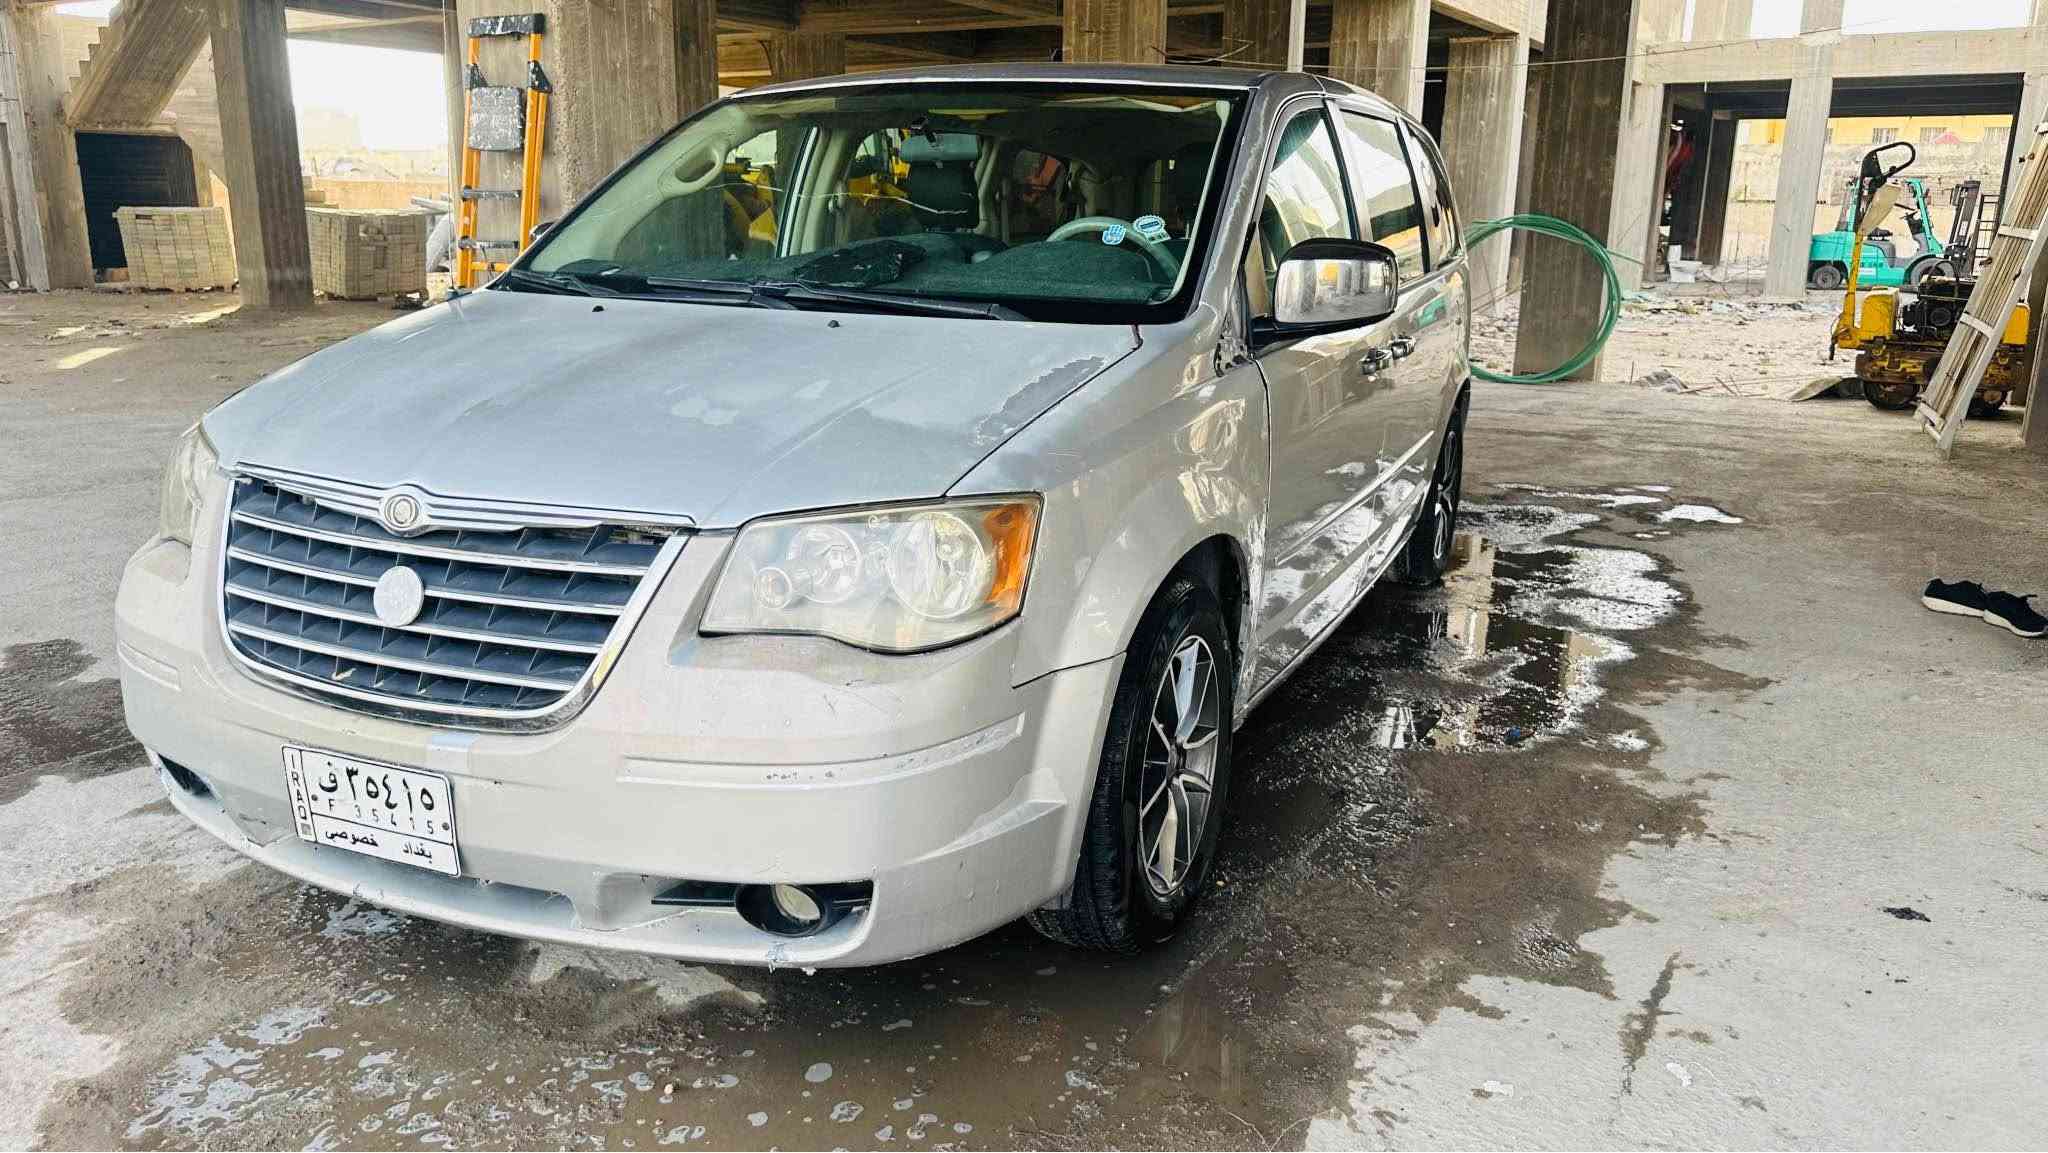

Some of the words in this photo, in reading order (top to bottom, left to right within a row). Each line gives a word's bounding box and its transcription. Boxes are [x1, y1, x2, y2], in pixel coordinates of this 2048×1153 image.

[291, 753, 308, 821] IRAQ
[345, 766, 435, 811] ٣٥٤١٥
[328, 798, 336, 812] F
[354, 804, 434, 835] 35415
[402, 841, 433, 864] بغداد
